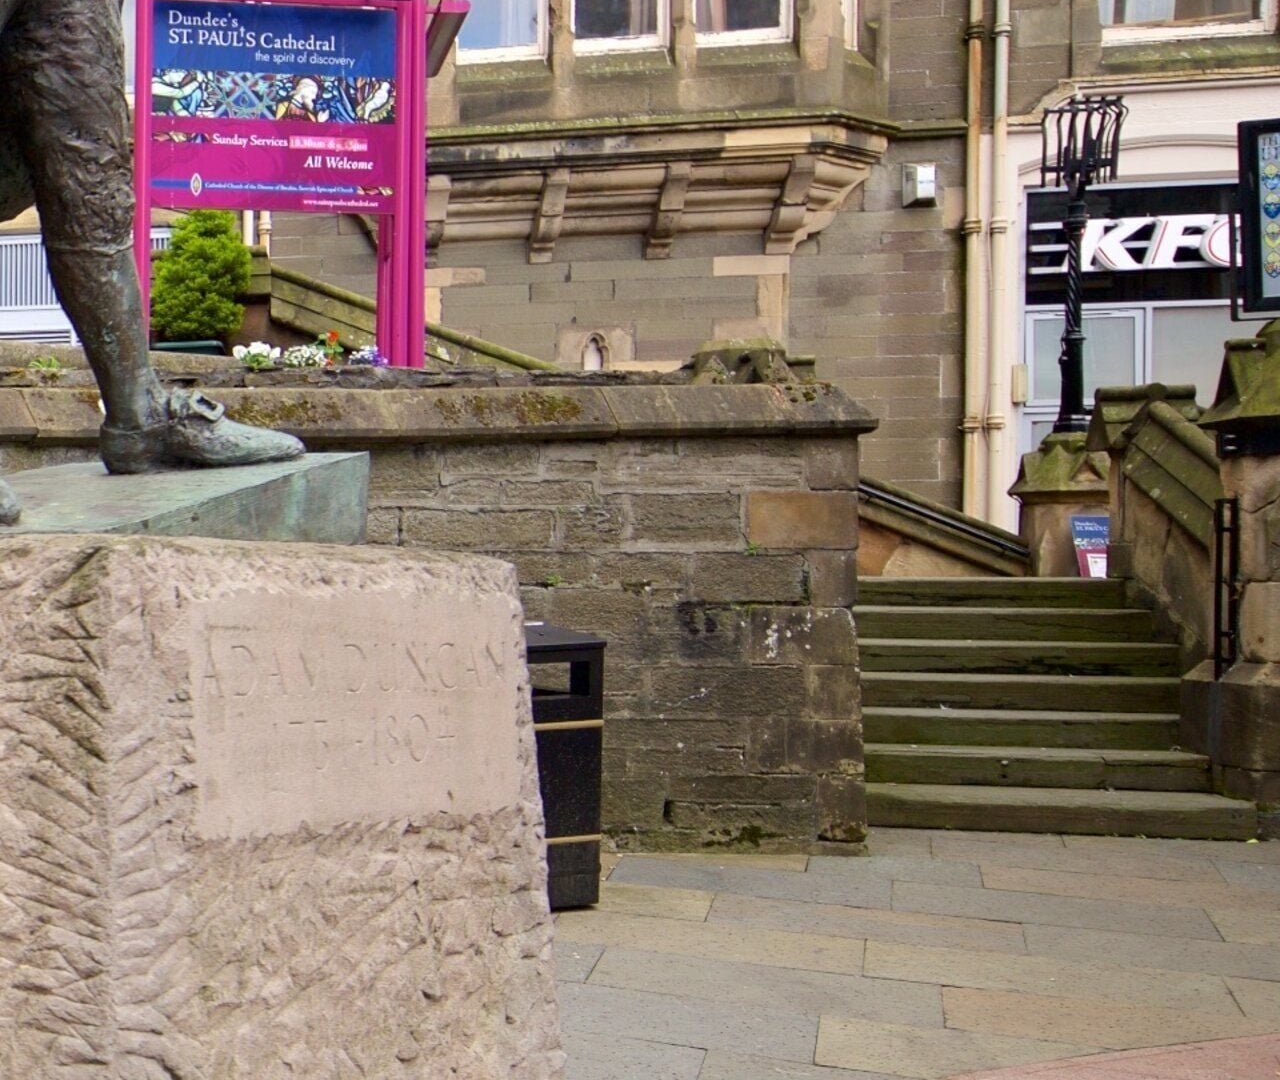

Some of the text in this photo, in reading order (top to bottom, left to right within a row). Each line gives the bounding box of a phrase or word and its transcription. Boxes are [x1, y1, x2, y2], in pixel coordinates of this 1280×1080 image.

[168, 10, 238, 27] Dundee's
[168, 28, 193, 45] ST.
[260, 33, 335, 51] Cathedral
[255, 51, 355, 68] the spirit of discovery
[212, 133, 247, 148] Sunday
[250, 134, 288, 147] Services
[304, 155, 374, 170] All Welcome
[343, 642, 506, 693] DUNCAN
